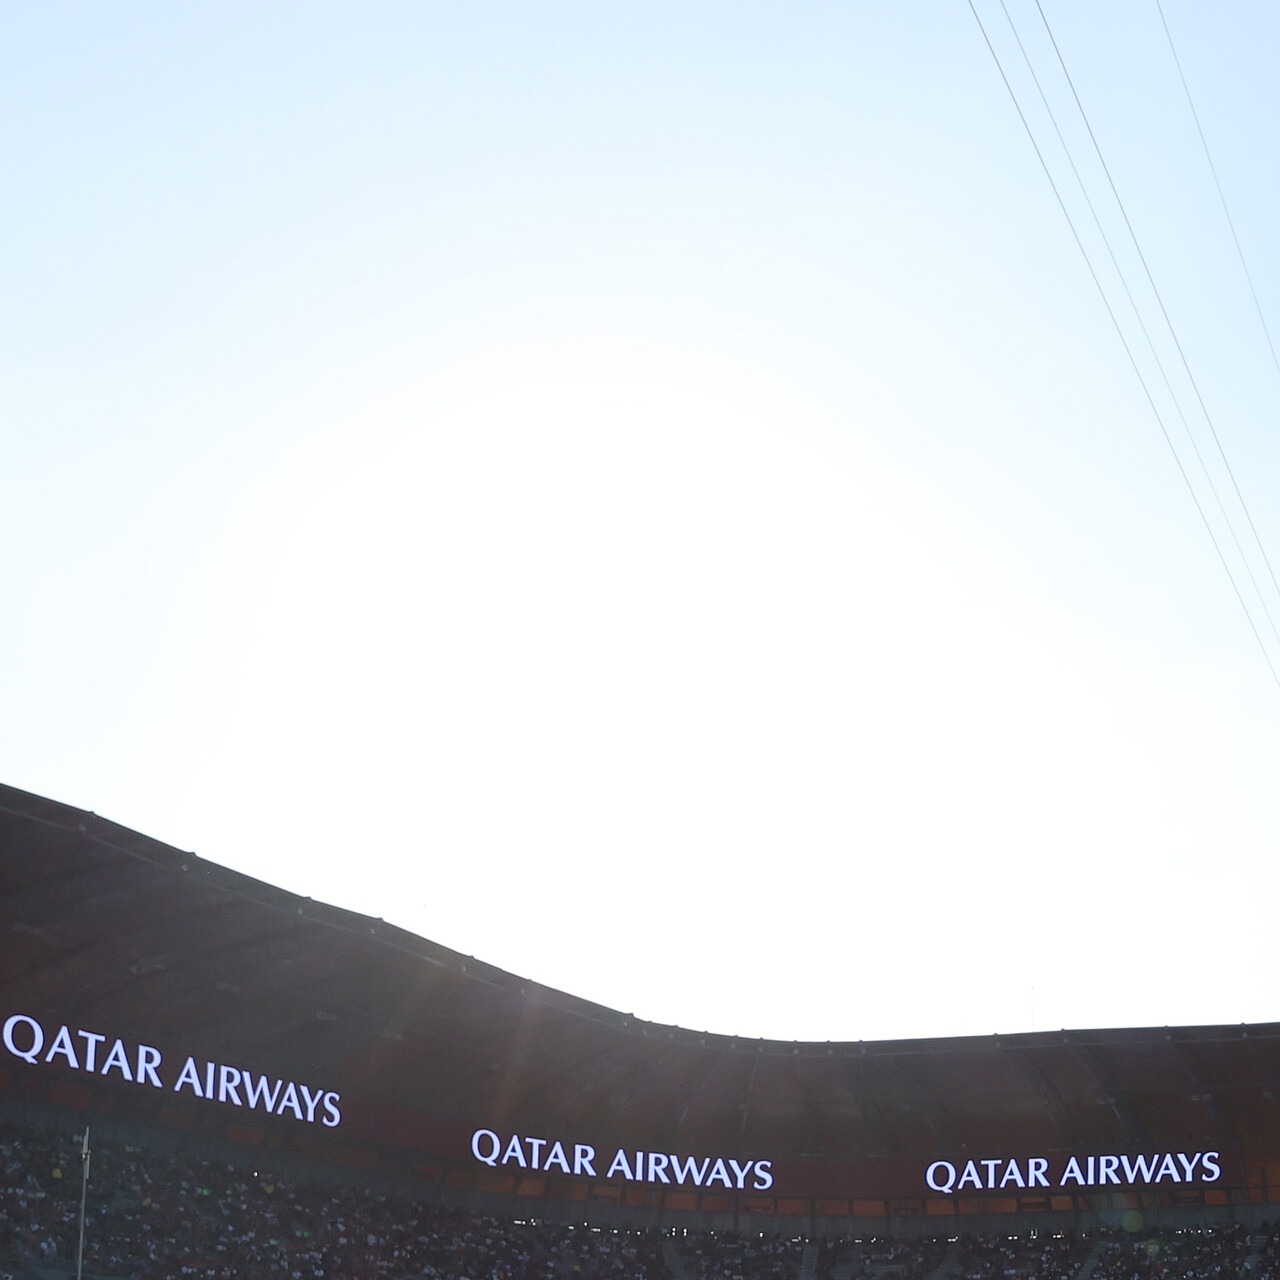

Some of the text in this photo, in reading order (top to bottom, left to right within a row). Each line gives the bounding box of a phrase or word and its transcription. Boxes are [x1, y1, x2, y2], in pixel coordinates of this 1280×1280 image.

[3, 1014, 341, 1127] QATAR AIRWAYS
[471, 1129, 774, 1190] QATAR AIRWAYS
[925, 1151, 1221, 1194] QATAR AIRWAYS
